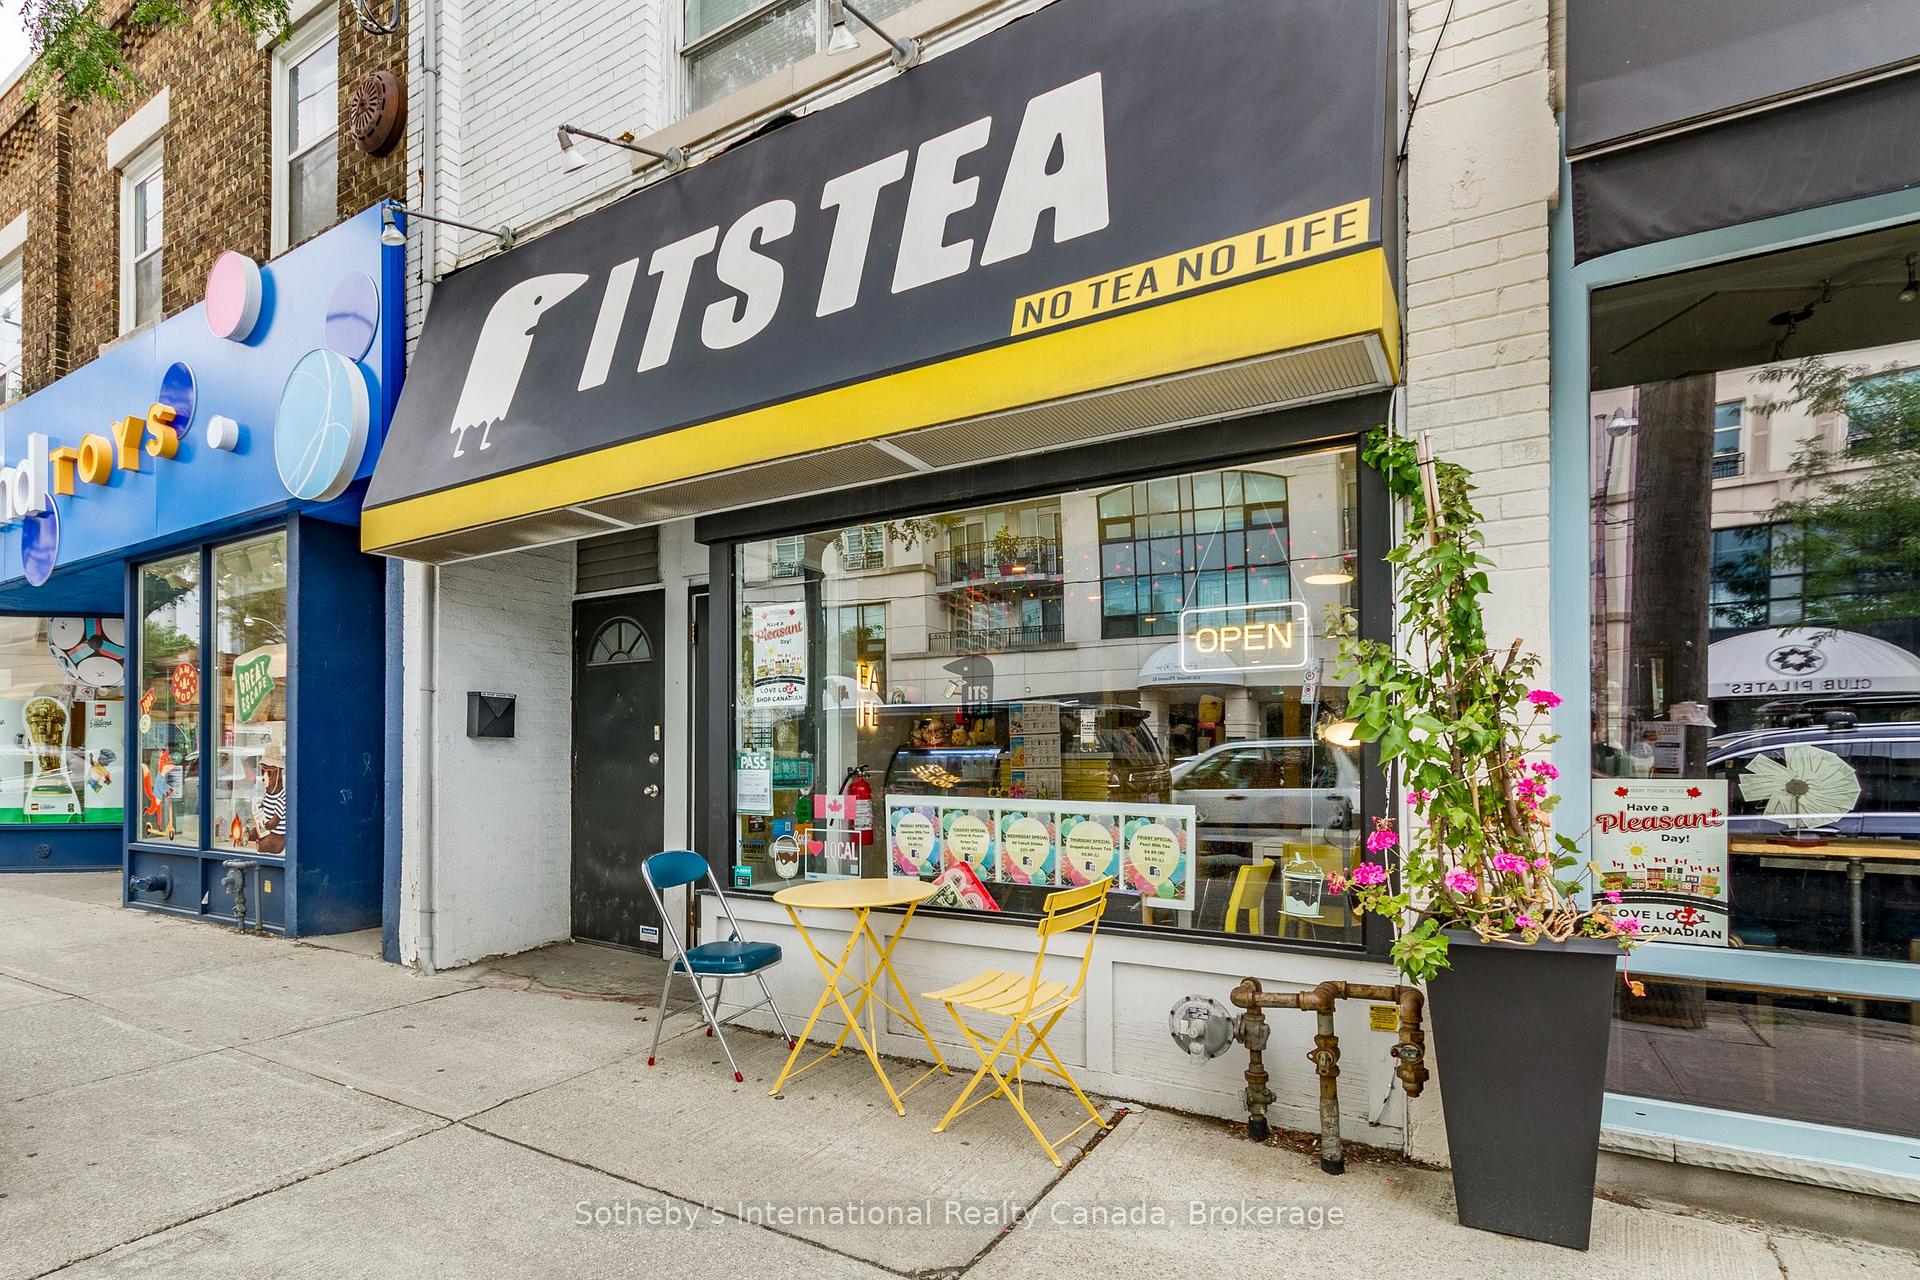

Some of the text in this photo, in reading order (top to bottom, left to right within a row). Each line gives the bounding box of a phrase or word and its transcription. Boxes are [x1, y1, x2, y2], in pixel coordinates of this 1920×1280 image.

[577, 72, 1109, 392] ITS TEA
[1021, 207, 1357, 329] NO TEA NO LIFE
[49, 402, 180, 496] TOYS
[755, 622, 804, 642] Pleasant
[1195, 622, 1292, 653] OPEN
[239, 661, 267, 695] GREAT
[174, 686, 195, 701] MODE
[241, 678, 268, 713] ESCAPE
[968, 685, 989, 700] ITS
[740, 756, 767, 769] PASS
[1627, 803, 1658, 812] Have
[1596, 808, 1724, 834] Pleasant
[1661, 834, 1690, 844] Day!
[824, 841, 858, 861] LOCAL
[1656, 911, 1710, 923] LOCAL
[1641, 925, 1721, 939] CANADIAN
